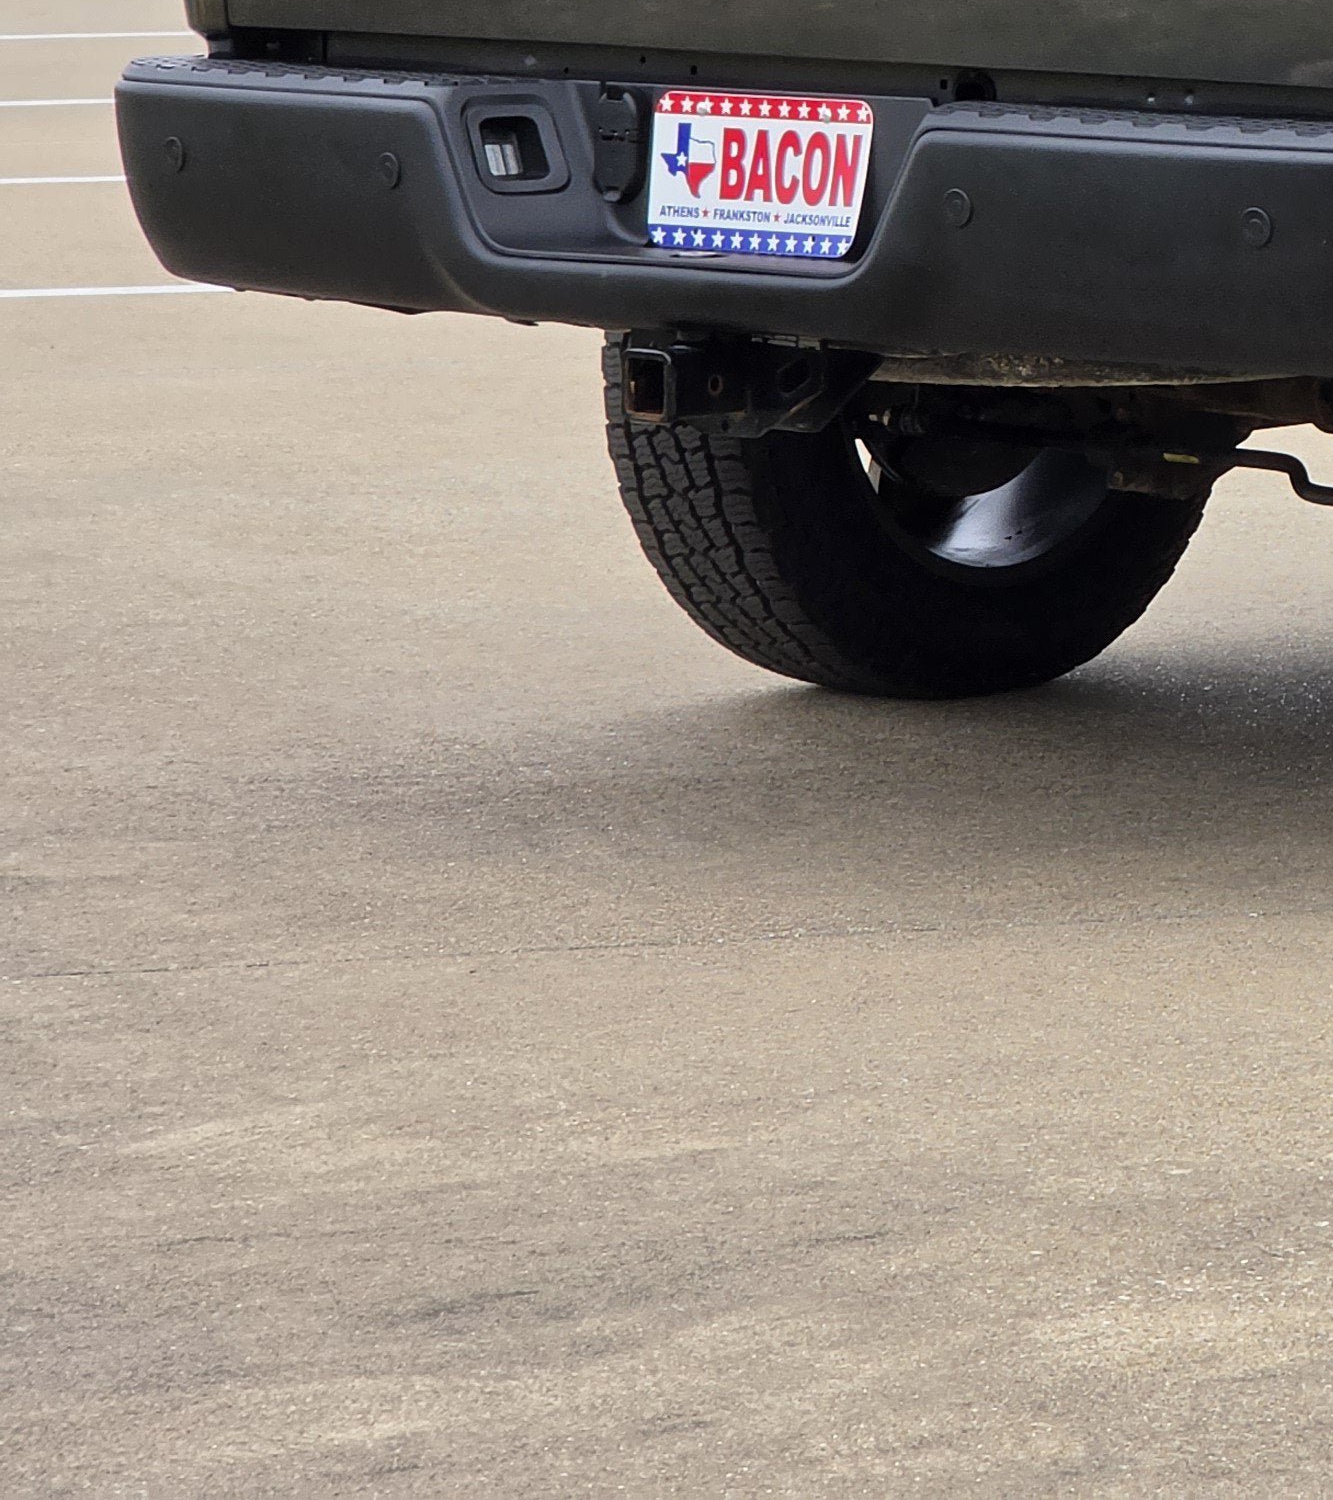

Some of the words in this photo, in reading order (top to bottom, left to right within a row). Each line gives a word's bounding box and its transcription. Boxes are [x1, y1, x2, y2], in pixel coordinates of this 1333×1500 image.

[719, 126, 864, 208] BACON
[659, 205, 700, 219] ATHENS
[713, 207, 771, 223] FRANKSTON
[783, 212, 851, 228] JACKSONVILLE
